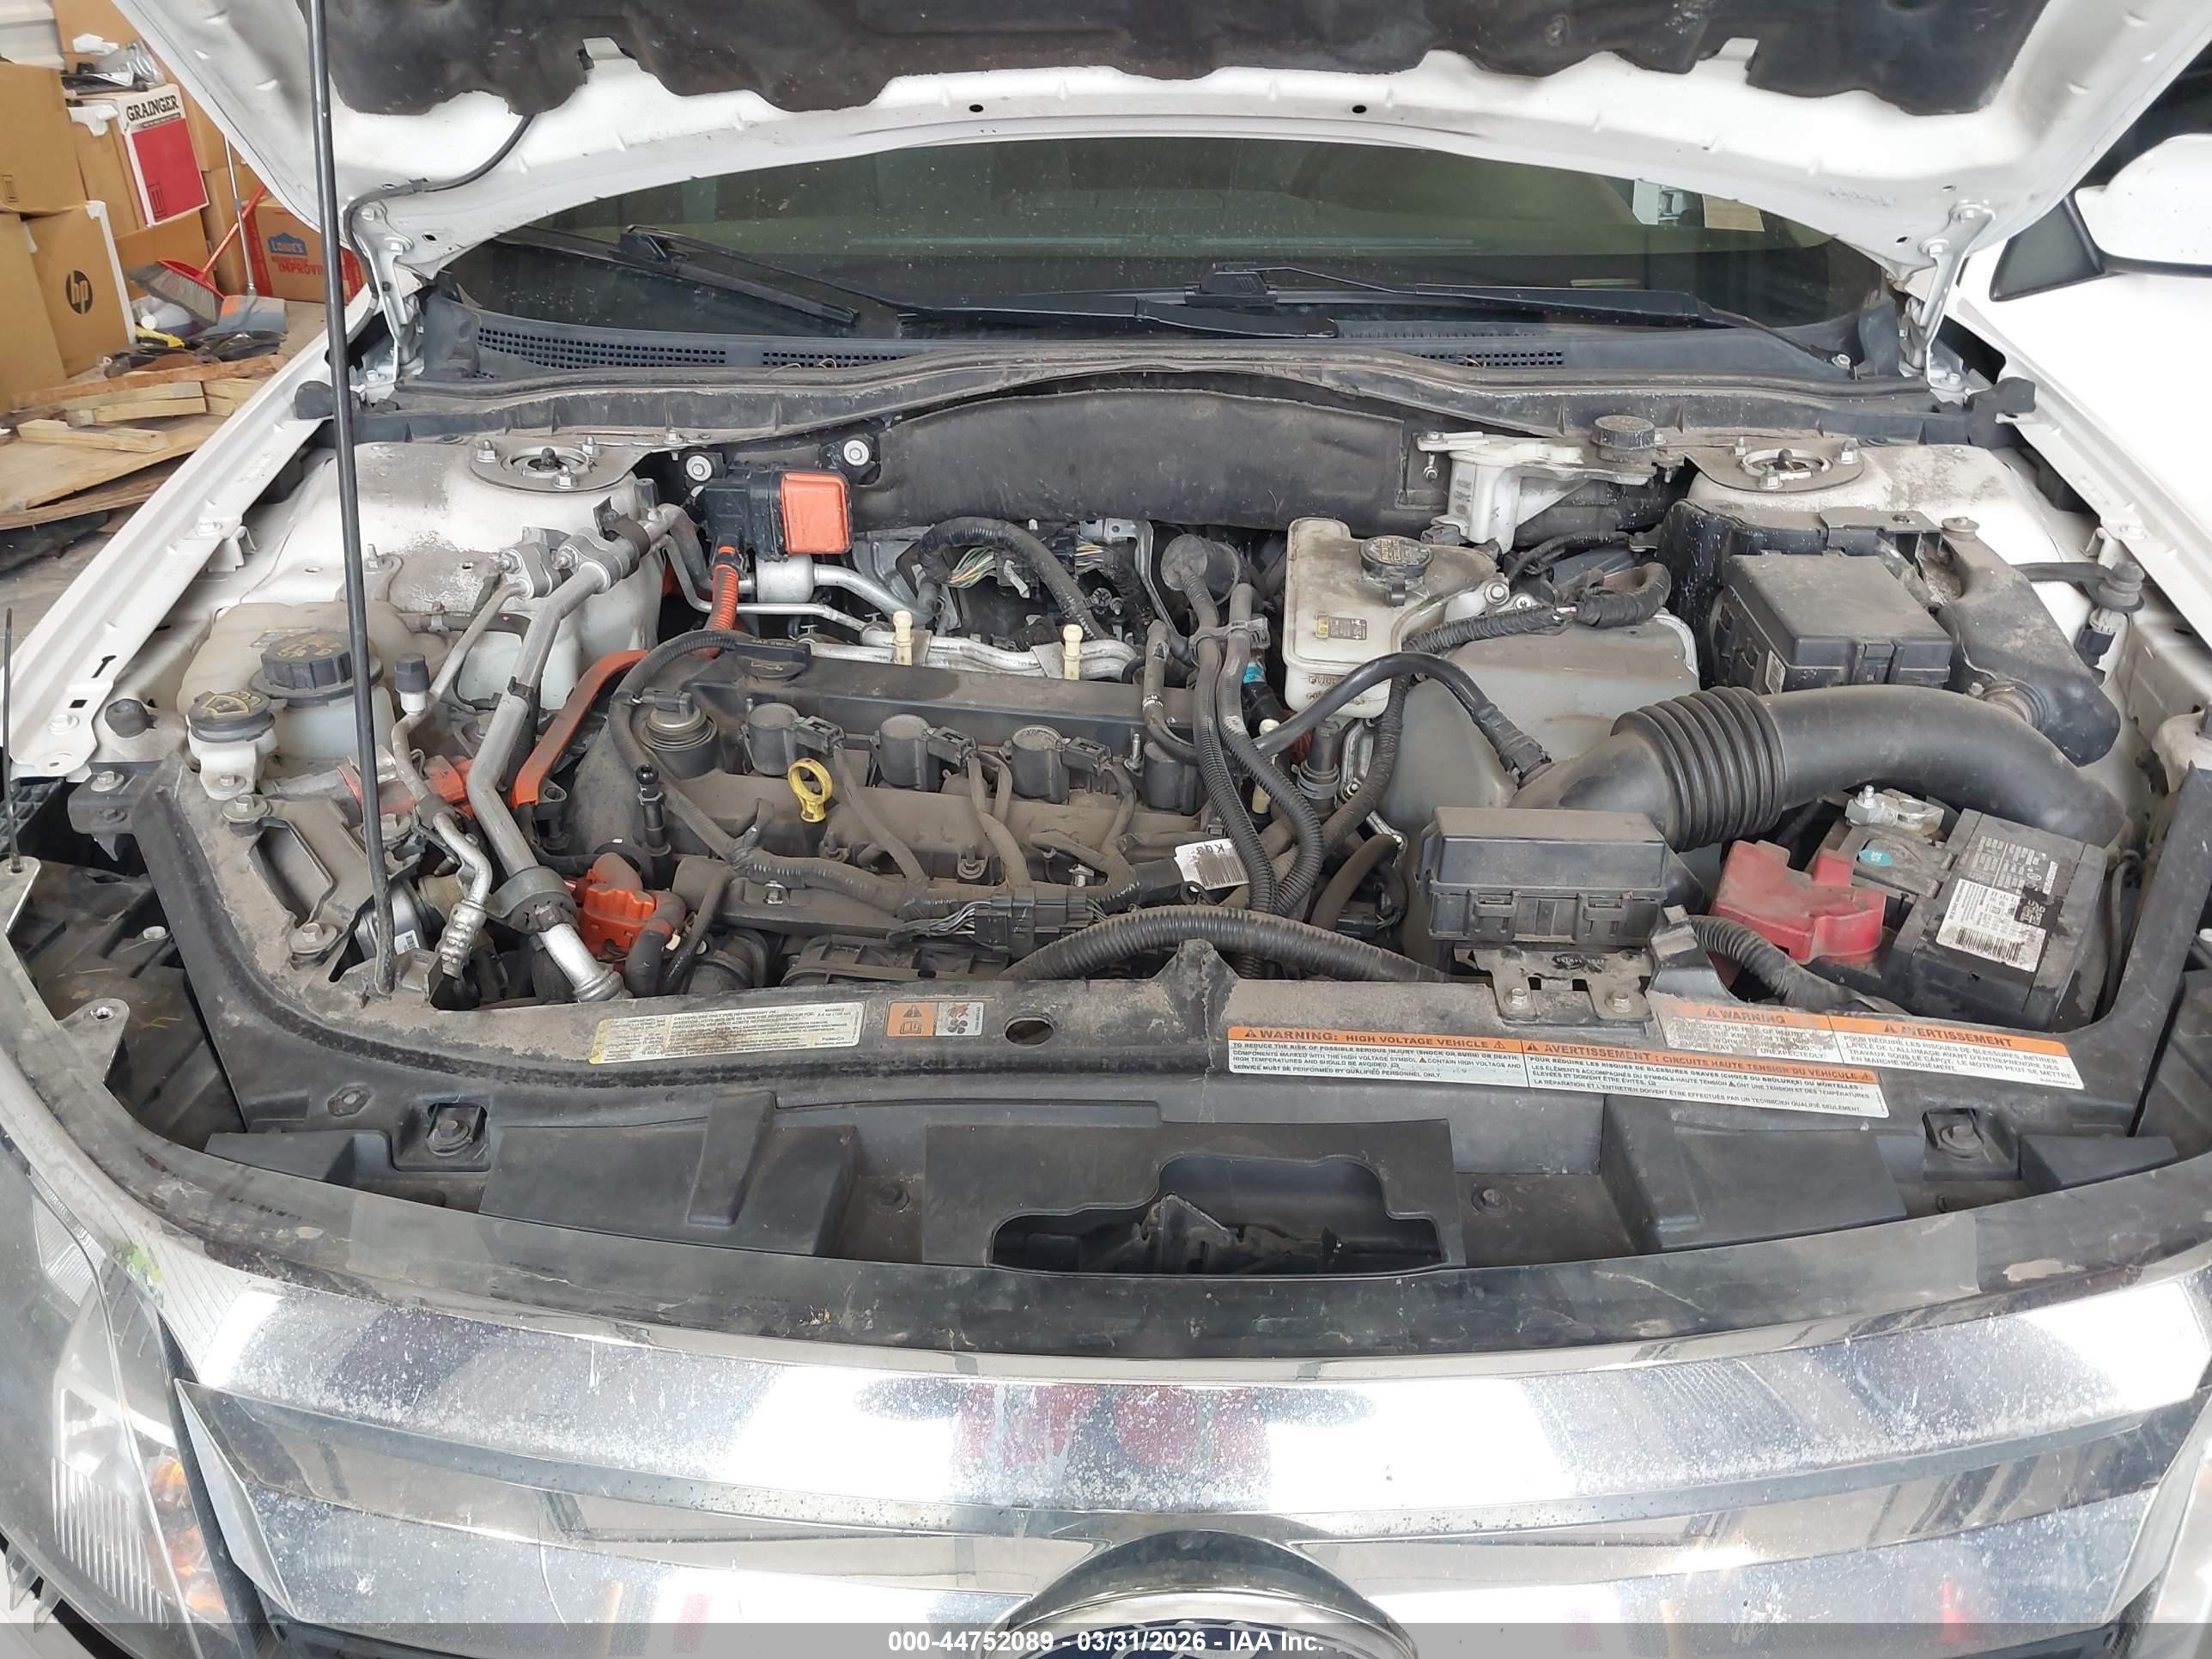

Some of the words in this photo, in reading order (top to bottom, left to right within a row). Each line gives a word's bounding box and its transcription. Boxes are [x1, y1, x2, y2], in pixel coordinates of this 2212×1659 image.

[126, 94, 179, 122] GRAINGER
[69, 270, 91, 315] hp
[1719, 1010, 1785, 1024] WARNING
[1260, 1029, 1337, 1041] WARNING:
[1379, 1036, 1435, 1045] VOLTAGE
[1436, 1038, 1488, 1048] VEHICLE
[1544, 1043, 1650, 1060] AVERTISSEMENT
[1662, 1056, 1708, 1066] CIRCUITS
[1711, 1060, 1744, 1069] HAUTE
[1747, 1063, 1787, 1073] TENSION
